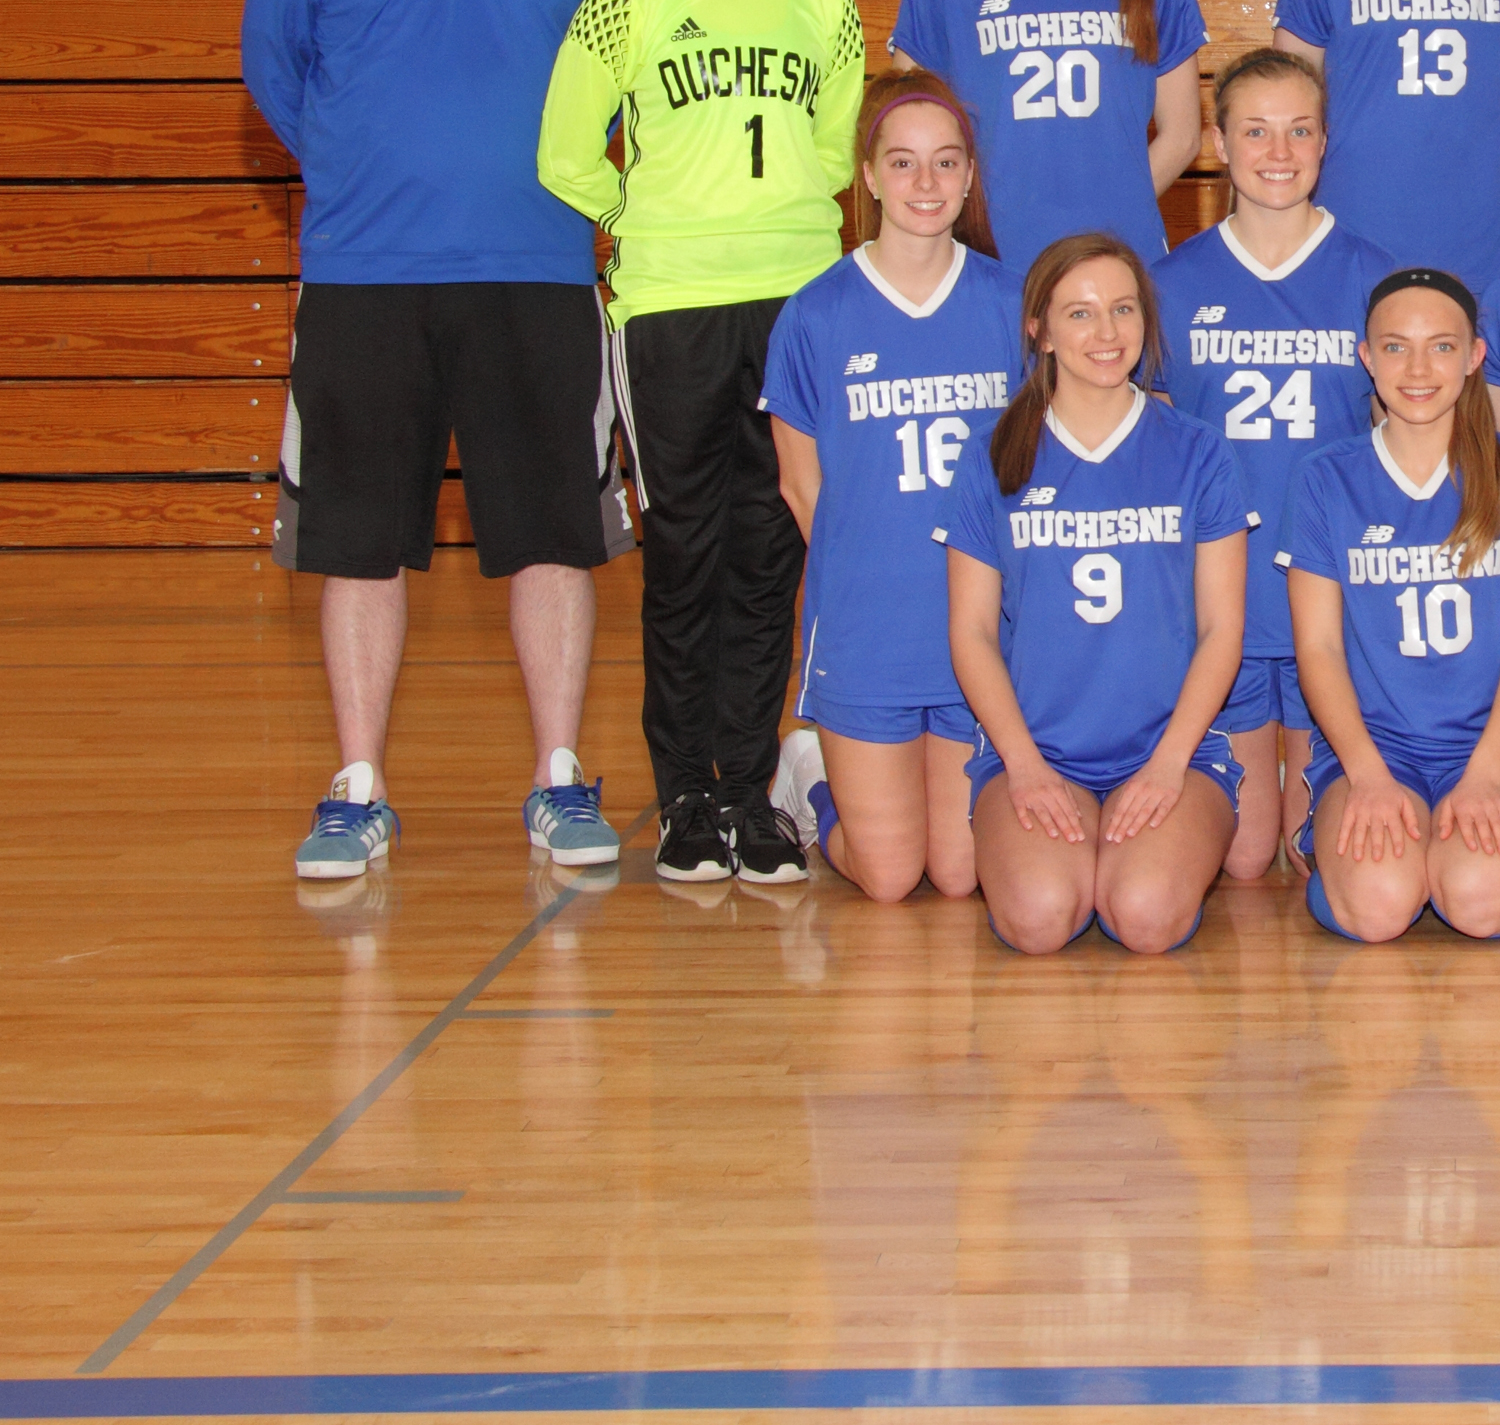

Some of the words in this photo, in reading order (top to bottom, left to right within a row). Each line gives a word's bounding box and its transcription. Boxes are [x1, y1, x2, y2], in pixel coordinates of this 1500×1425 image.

[671, 30, 708, 42] adidas
[1397, 28, 1468, 96] 13
[1009, 50, 1100, 121] 20
[745, 114, 764, 179] 1
[1189, 329, 1357, 367] DUCHESNE
[846, 372, 1009, 421] DUCHESNE
[1224, 369, 1316, 440] 24
[896, 416, 970, 492] 16
[1009, 506, 1183, 549] DUCHESNE
[1072, 552, 1123, 624] 9
[1395, 583, 1473, 657] 10
